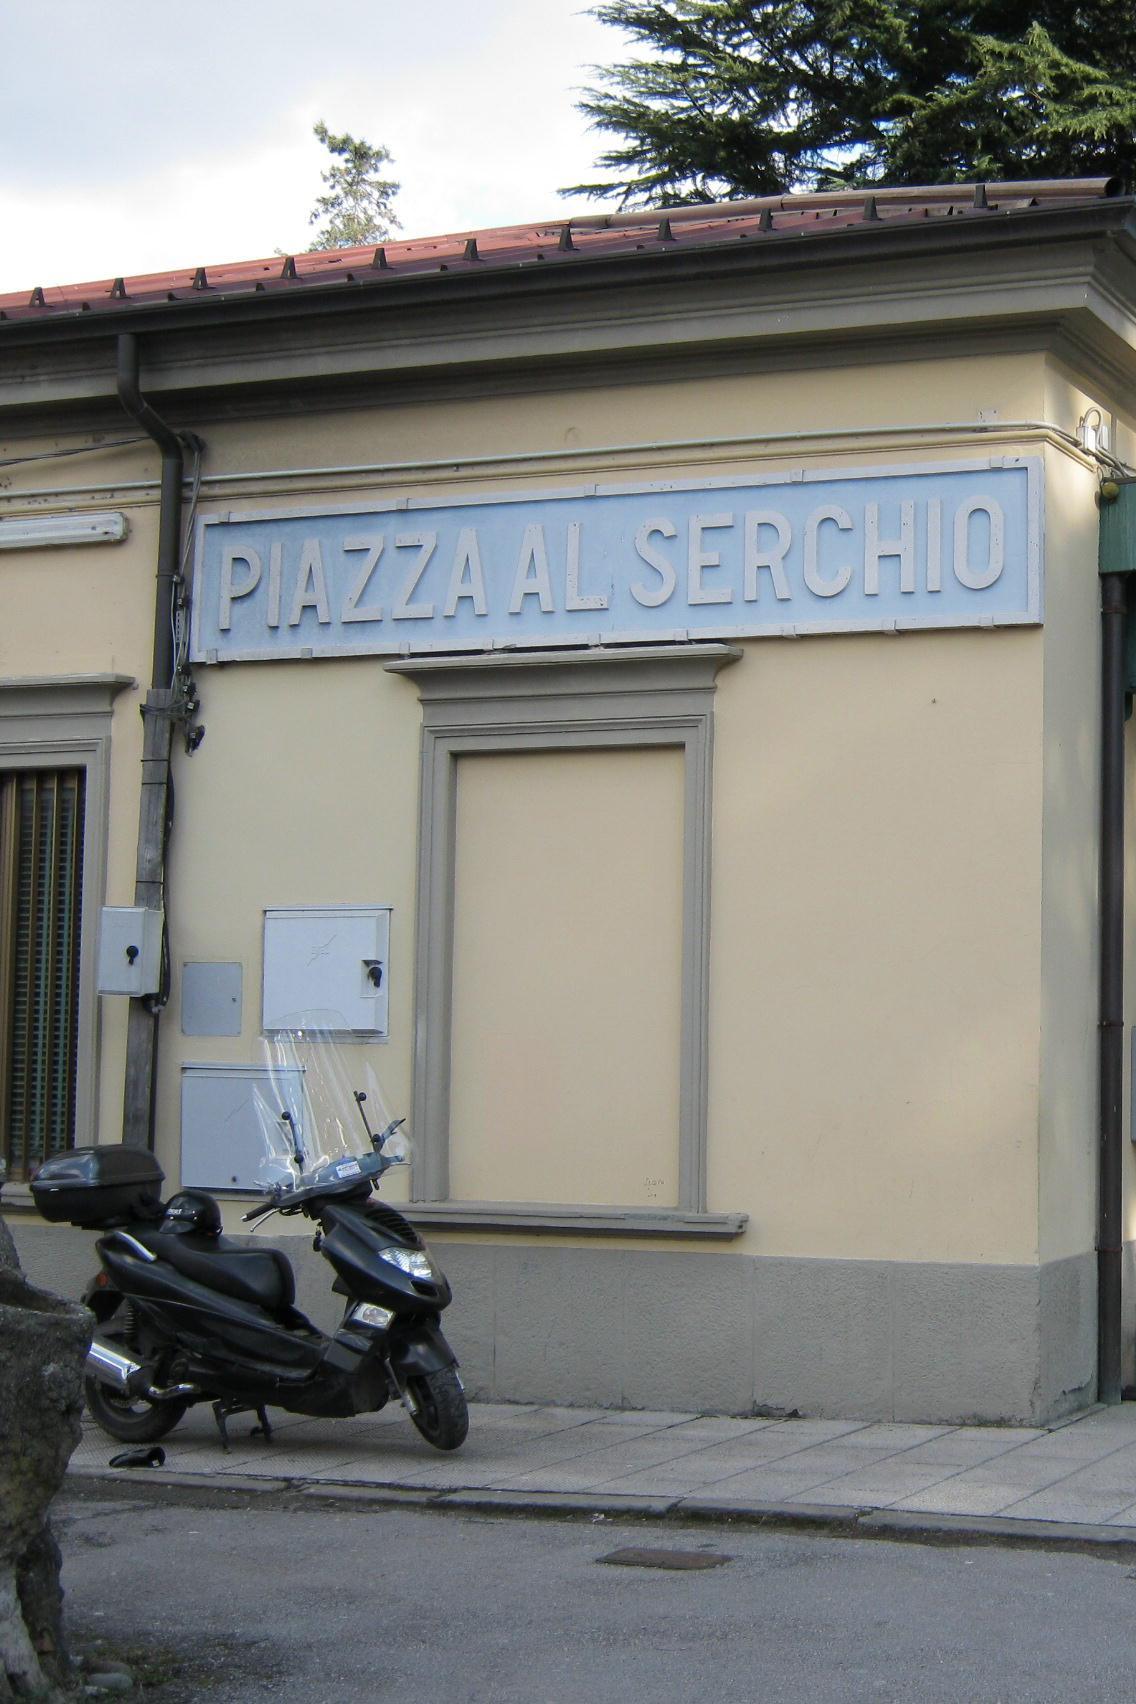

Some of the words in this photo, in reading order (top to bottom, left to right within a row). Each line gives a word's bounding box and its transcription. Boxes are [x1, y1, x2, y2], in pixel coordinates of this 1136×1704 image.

[219, 528, 488, 631] PIAZZA
[508, 522, 608, 615] AL
[630, 495, 1004, 608] SERCHIO
